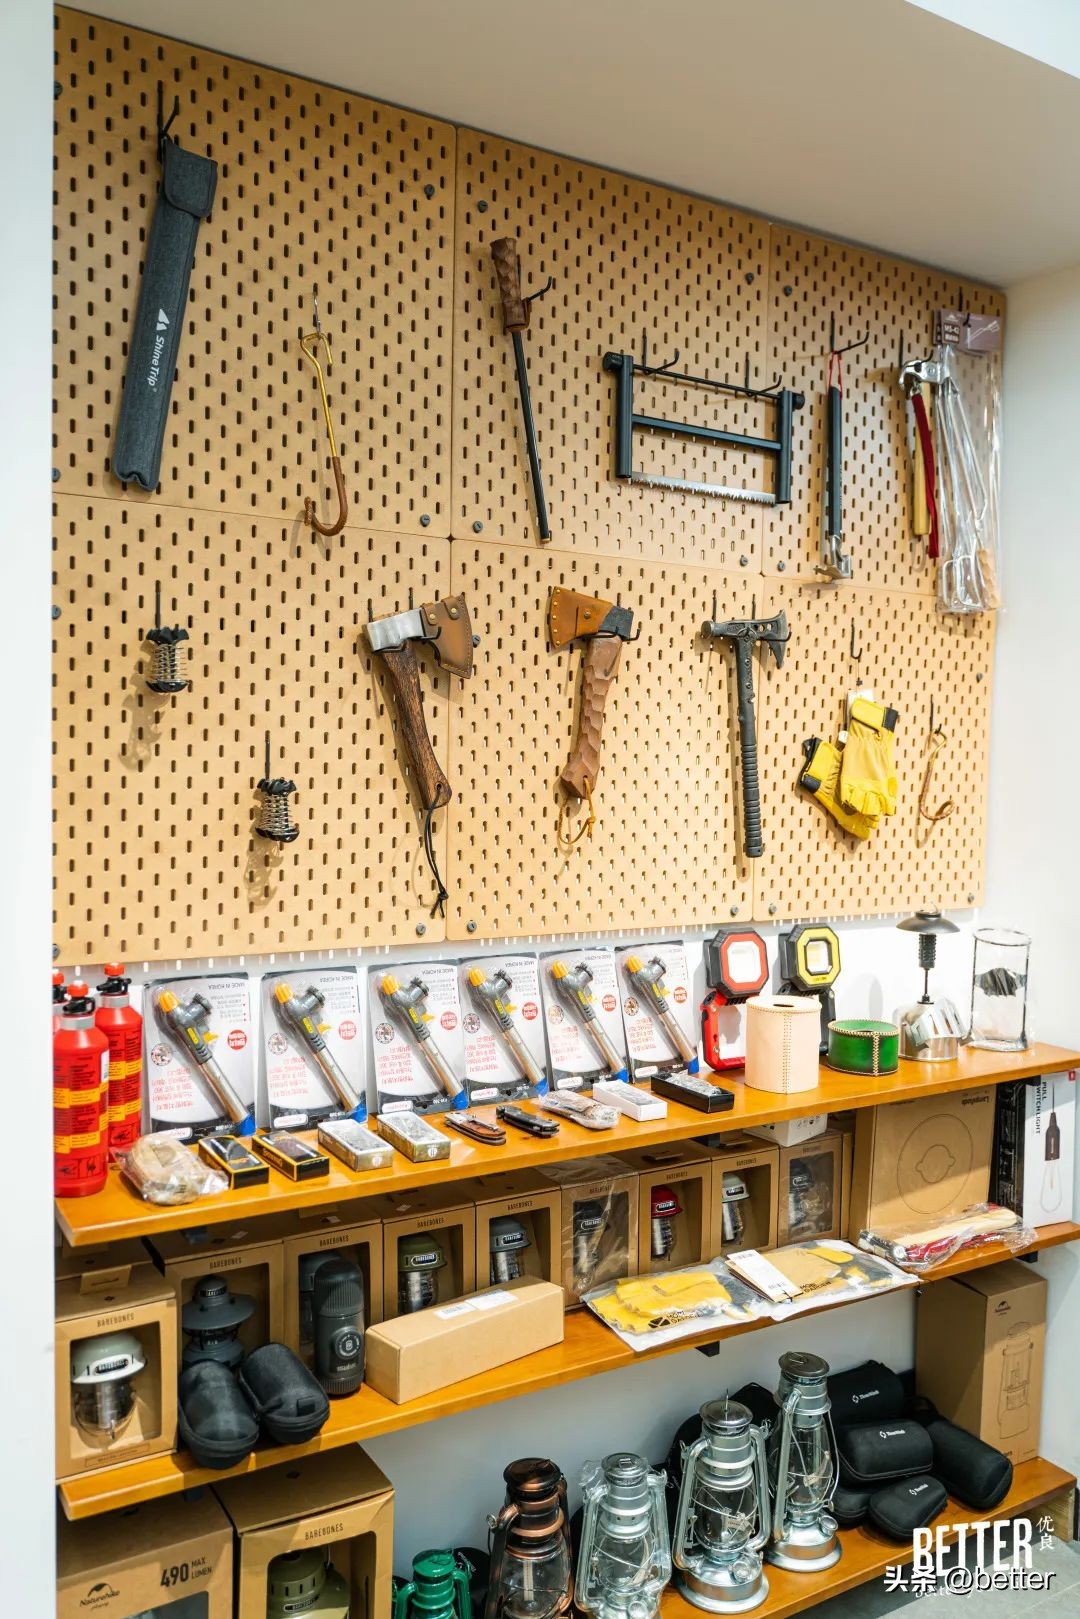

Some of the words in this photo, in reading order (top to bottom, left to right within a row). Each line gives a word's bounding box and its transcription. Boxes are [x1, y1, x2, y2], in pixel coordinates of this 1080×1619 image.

[97, 1312, 135, 1328] BAREBONES
[304, 1522, 344, 1541] BAREBONES
[191, 1556, 206, 1566] MAX
[160, 1563, 189, 1588] 490
[191, 1566, 212, 1580] LUMEN
